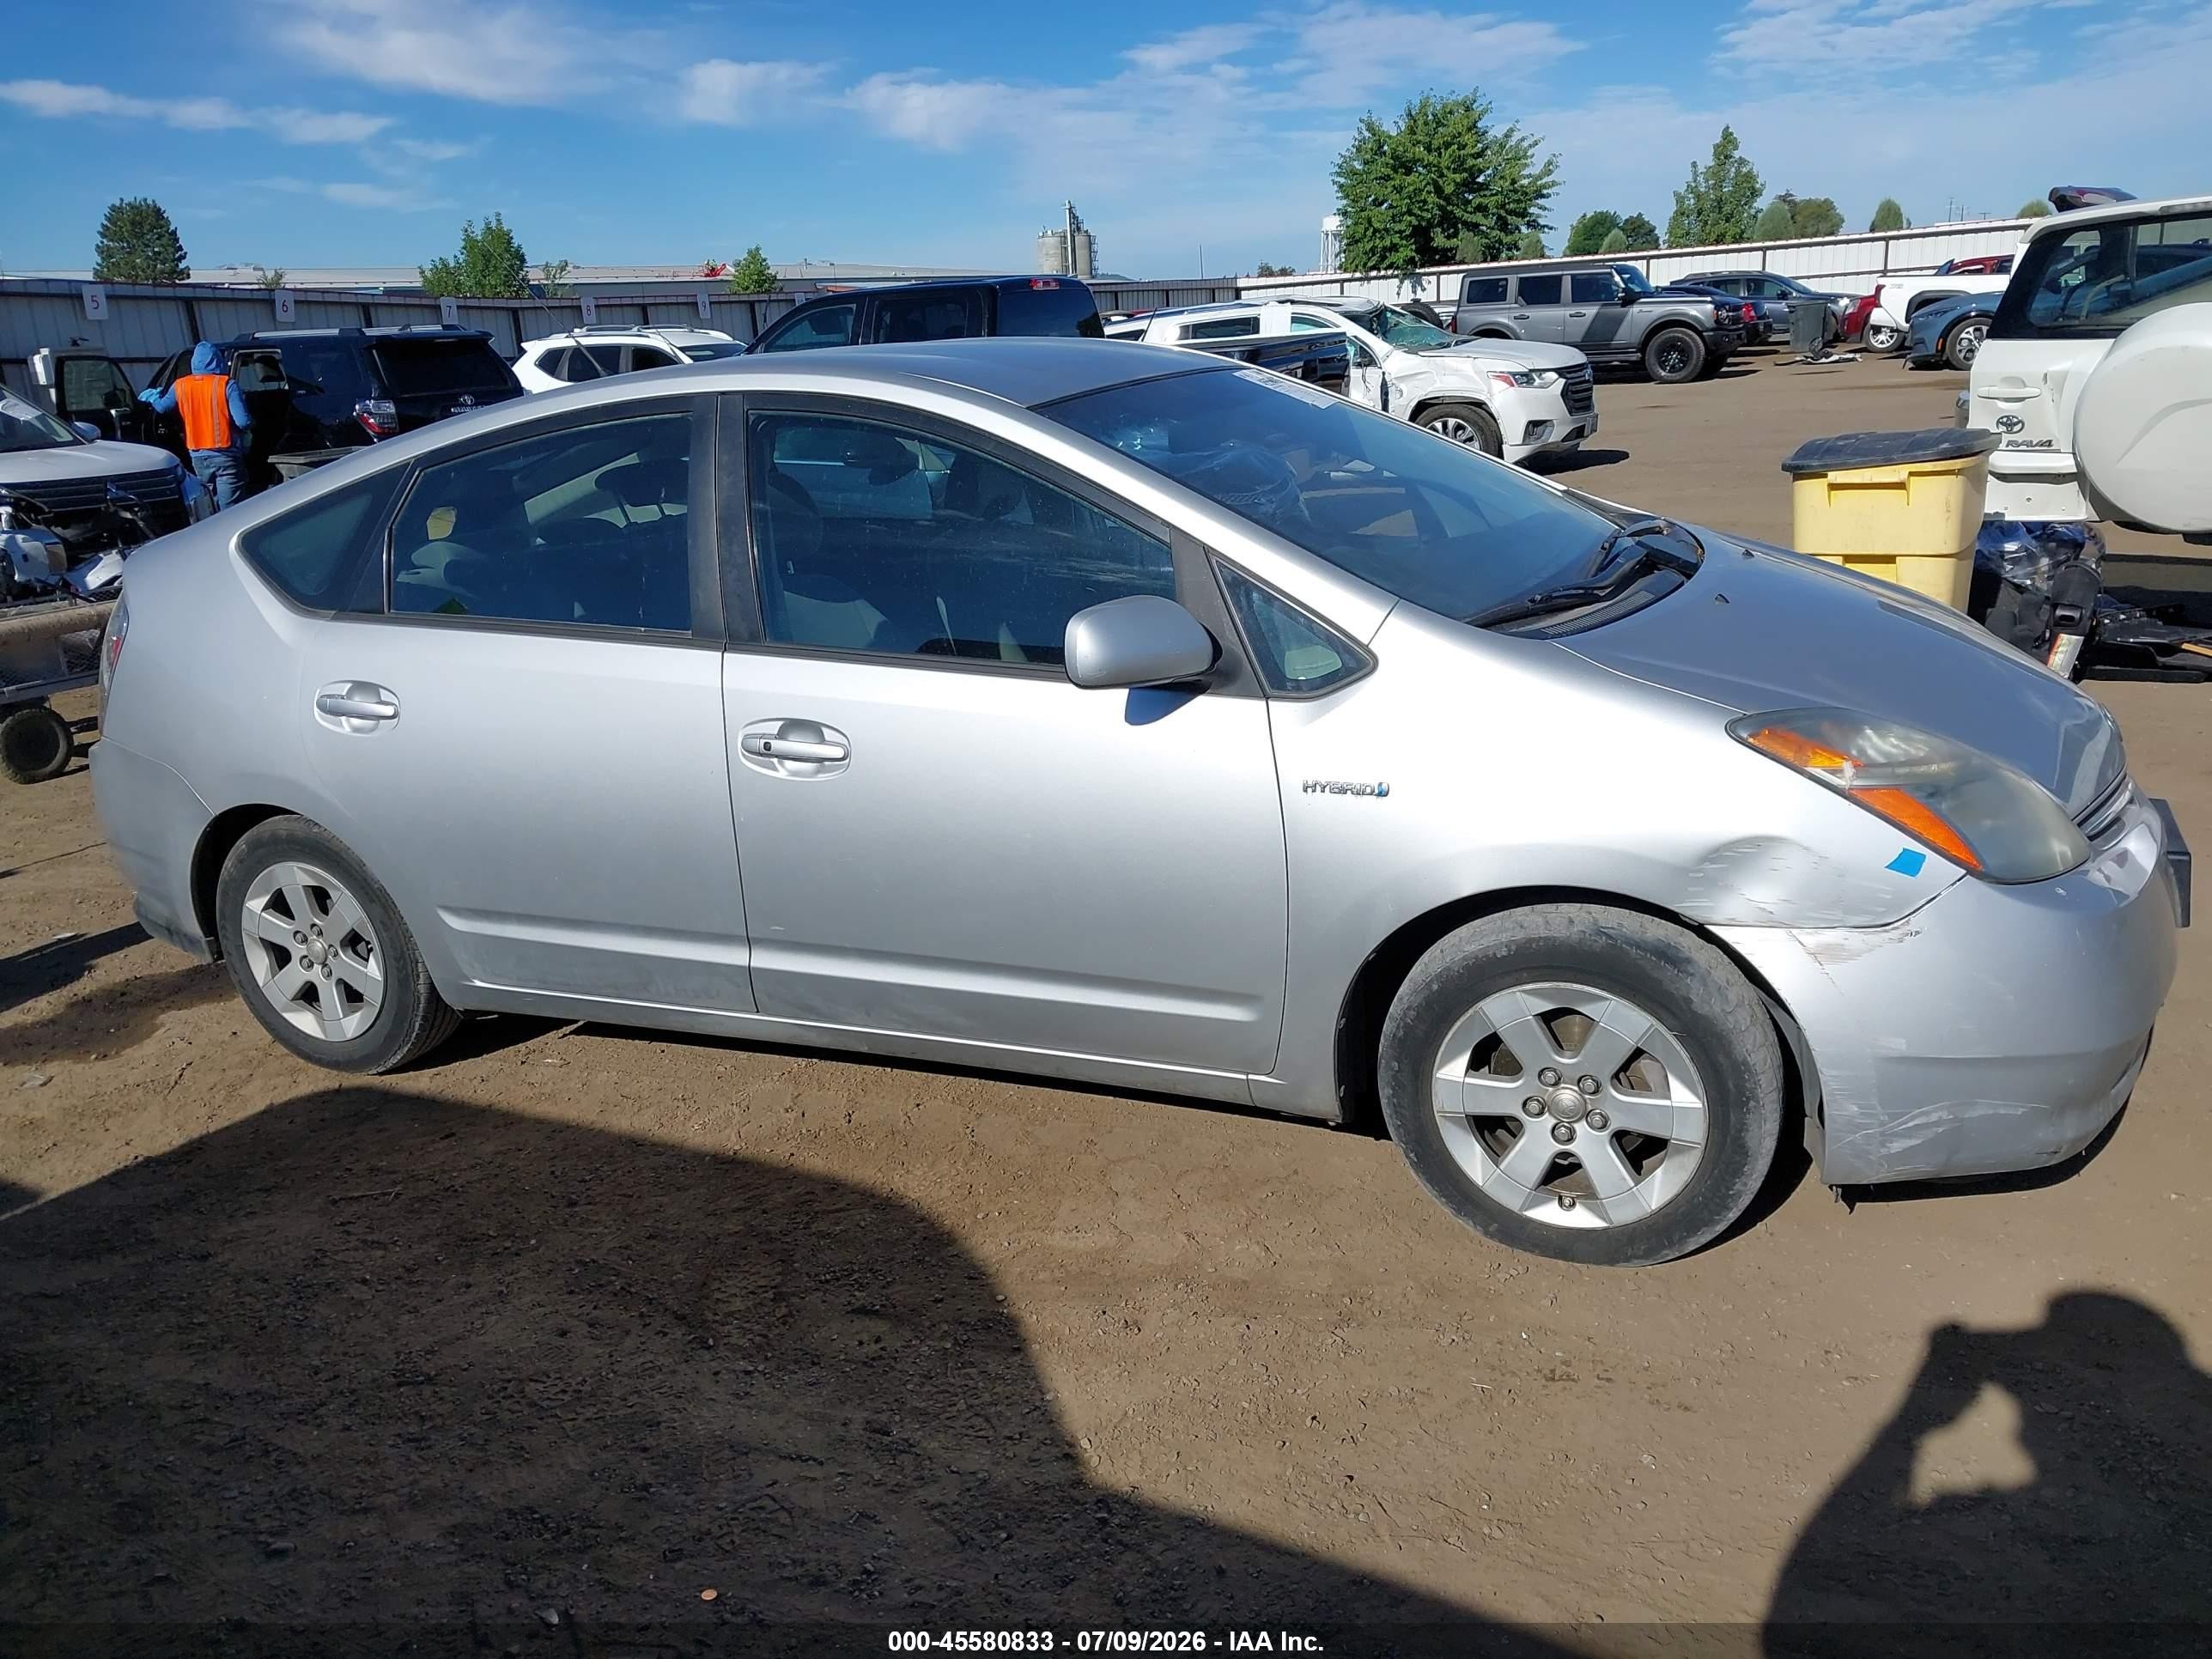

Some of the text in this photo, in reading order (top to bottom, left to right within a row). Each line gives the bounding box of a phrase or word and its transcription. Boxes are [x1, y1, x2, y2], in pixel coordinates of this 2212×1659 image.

[90, 295, 100, 310] 5
[281, 299, 289, 313] 6
[701, 301, 707, 312] 9
[446, 305, 453, 319] 7
[586, 304, 592, 317] 8
[2006, 438, 2054, 448] RAV4
[1303, 780, 1375, 796] HYBRID
